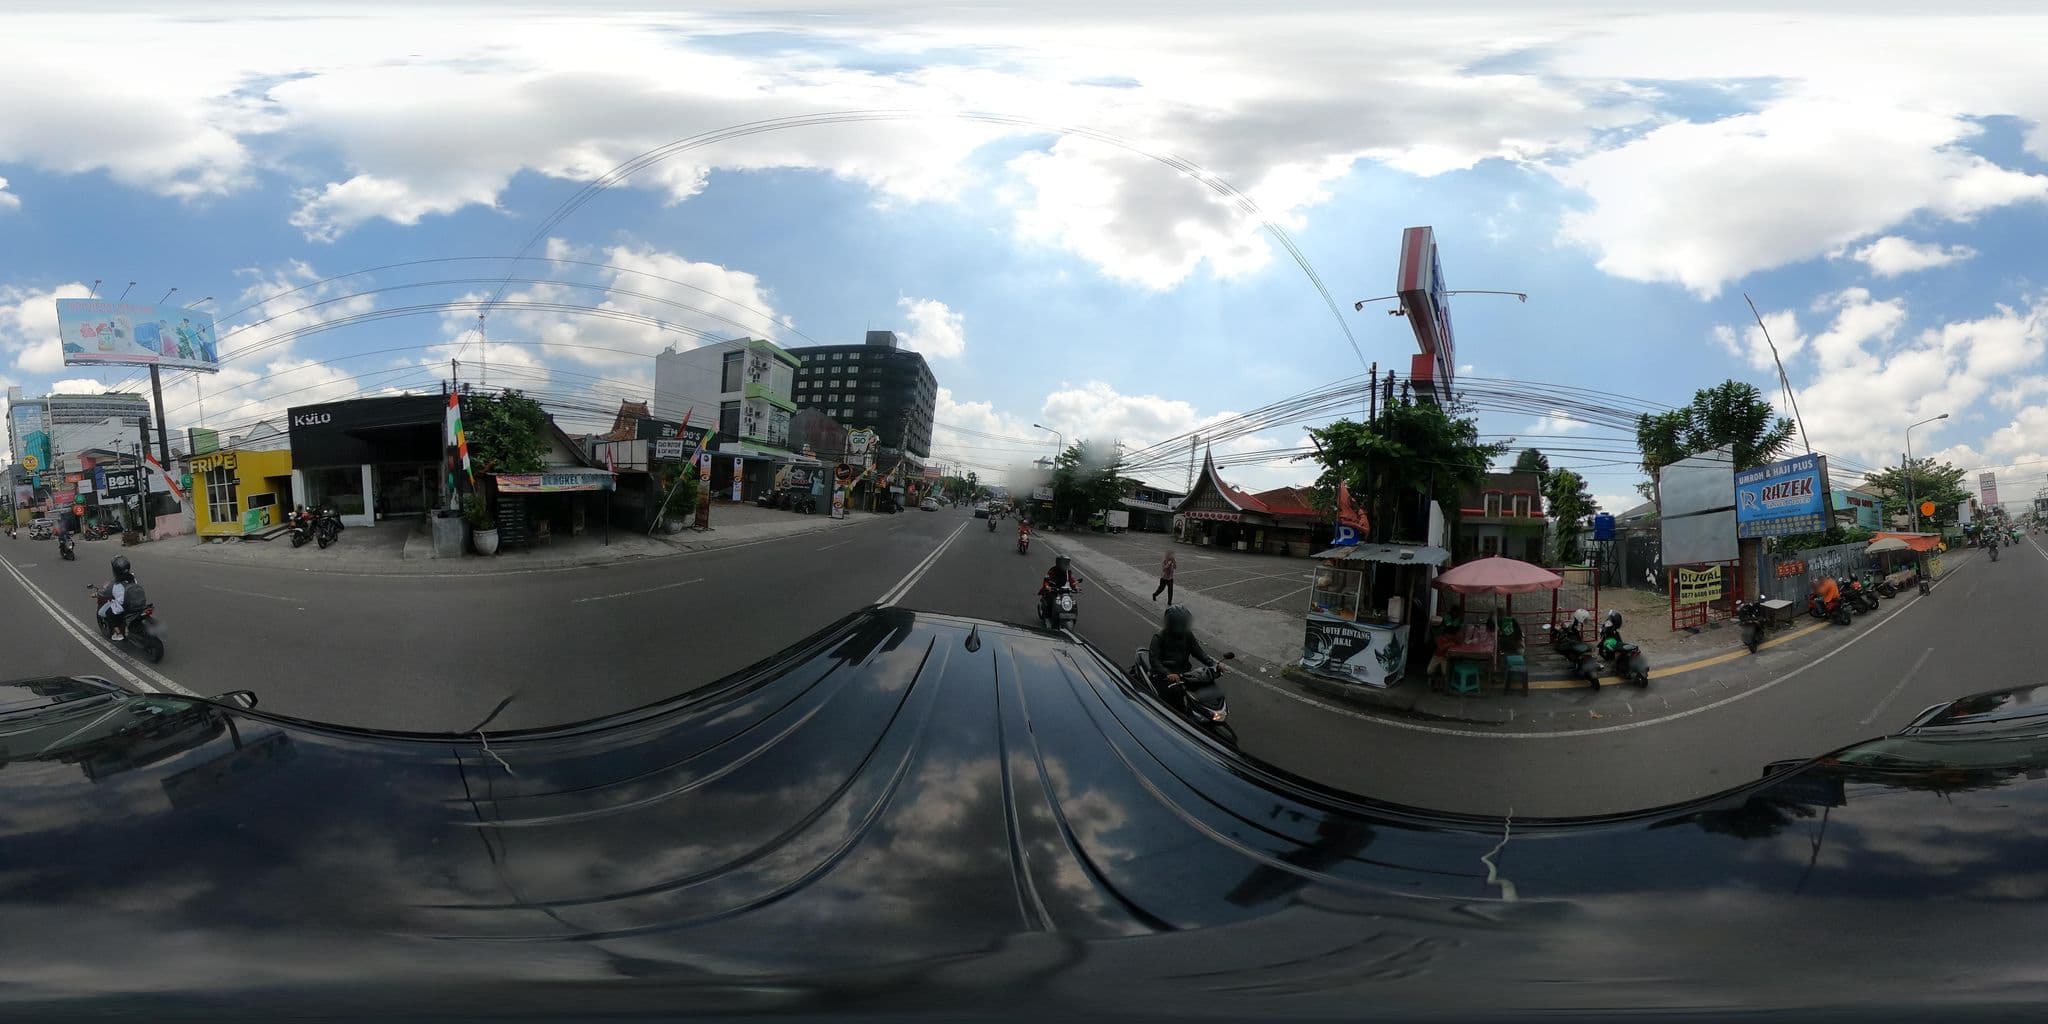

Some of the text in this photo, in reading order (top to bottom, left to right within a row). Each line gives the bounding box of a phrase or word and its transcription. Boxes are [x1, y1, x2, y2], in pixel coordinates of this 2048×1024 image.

[1739, 473, 1764, 485] UMROH
[1773, 466, 1792, 476] HAJI
[1793, 460, 1814, 472] PLUS
[108, 475, 135, 487] BOIS
[1681, 571, 1721, 583] DIJUAL
